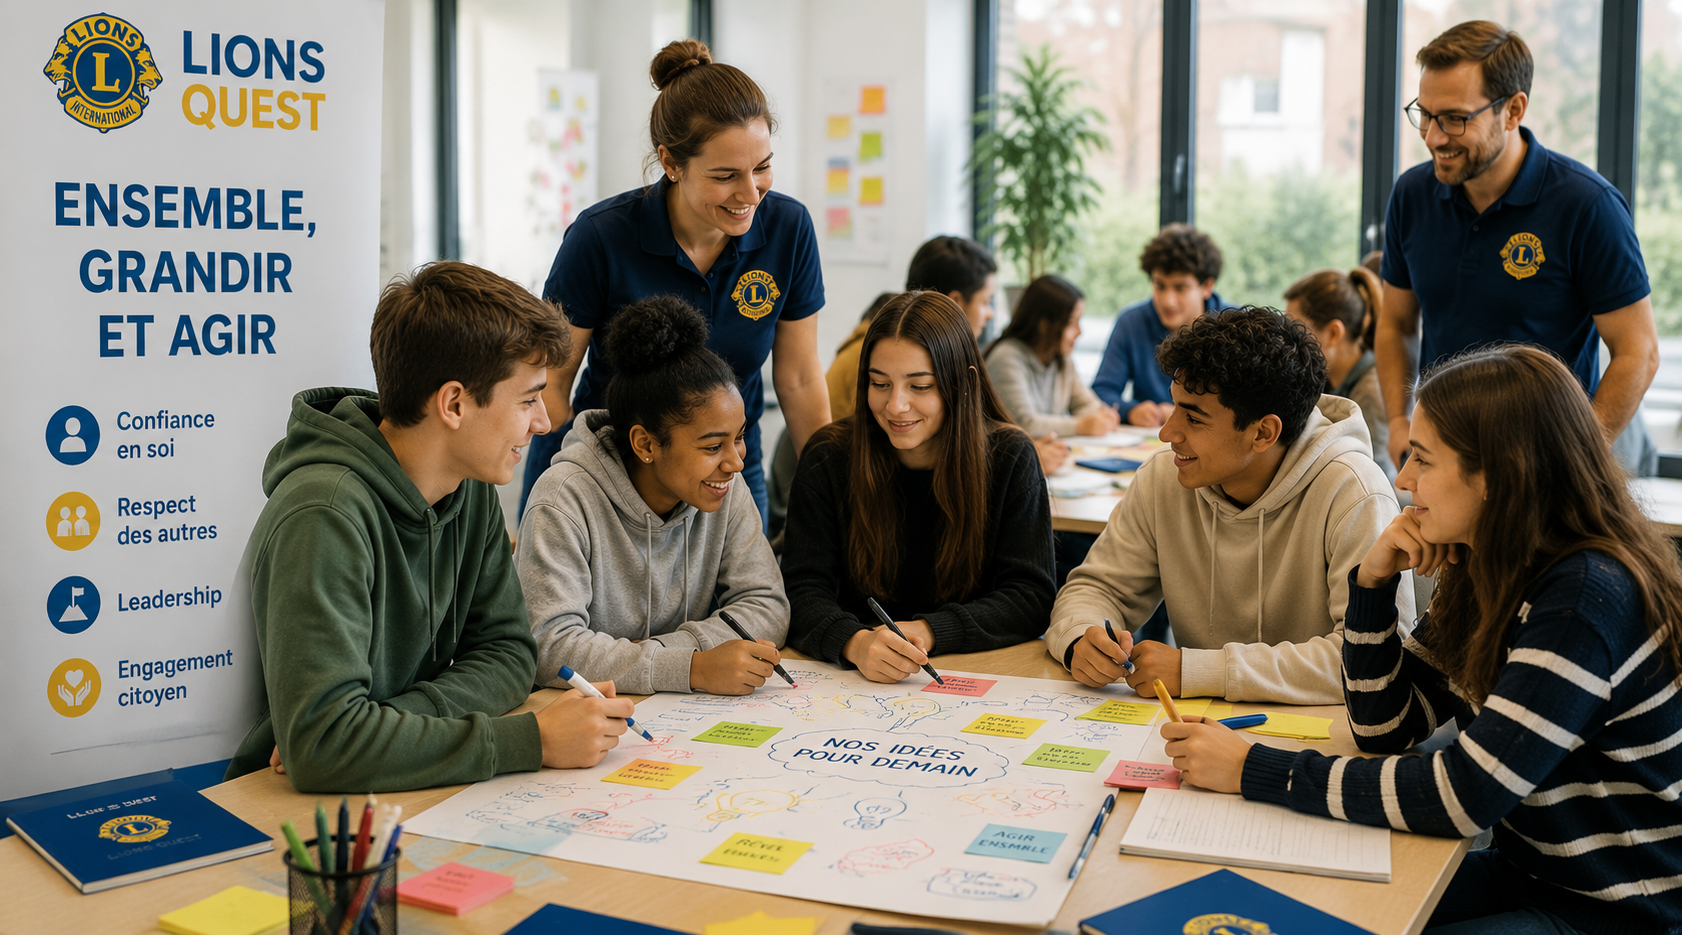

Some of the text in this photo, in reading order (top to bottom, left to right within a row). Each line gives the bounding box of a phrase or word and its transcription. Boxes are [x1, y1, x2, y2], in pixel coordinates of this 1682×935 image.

[70, 18, 139, 48] LIONS
[183, 30, 326, 84] LIONS
[91, 52, 121, 93] L
[69, 100, 137, 125] INTERNATIONAL
[181, 84, 327, 131] QUEST
[54, 181, 317, 238] ENSEMBLE,
[79, 248, 293, 294] GRANDIR
[749, 285, 764, 303] L
[99, 313, 277, 358] ET AGIR
[116, 409, 215, 431] Confiance
[116, 438, 175, 459] en soi
[117, 495, 197, 520] Respect
[117, 523, 218, 545] des autres
[118, 585, 222, 612] Leadership
[118, 649, 233, 681] Engagement
[117, 685, 188, 707] citoyen
[793, 748, 979, 777] POUR DEMAIN
[823, 737, 965, 761] NOS IDÉES
[992, 830, 1035, 842] AGIR
